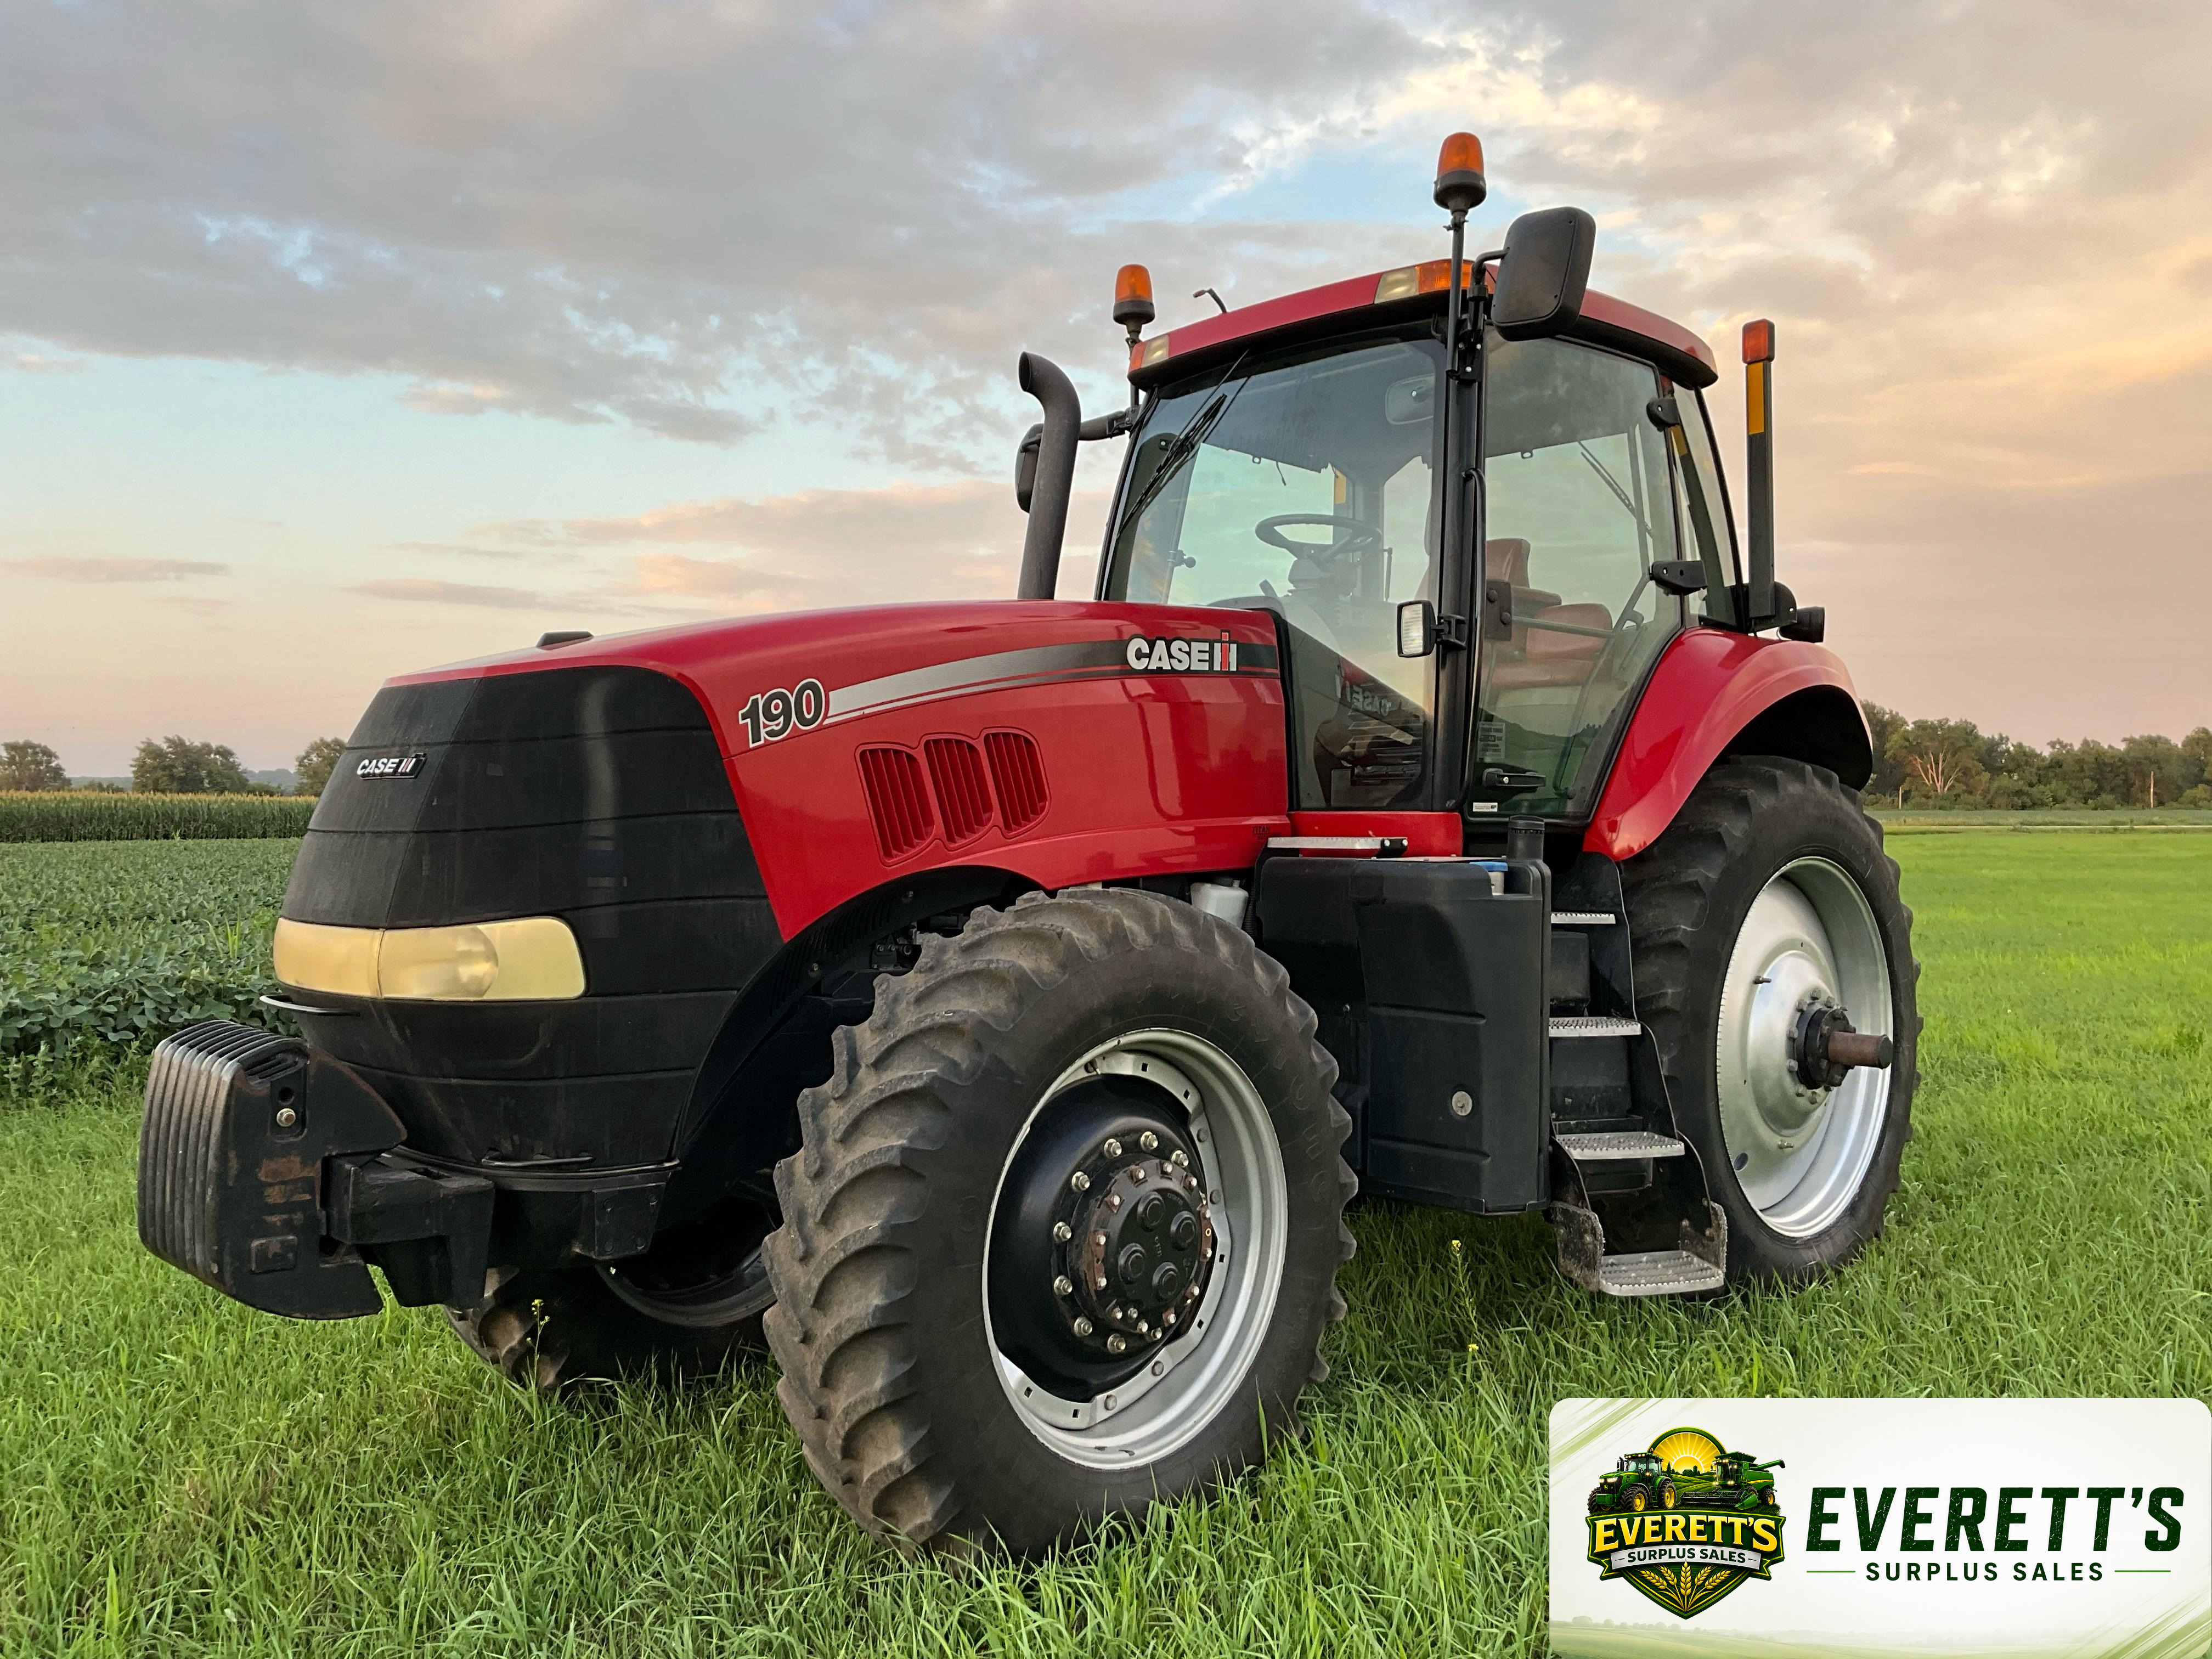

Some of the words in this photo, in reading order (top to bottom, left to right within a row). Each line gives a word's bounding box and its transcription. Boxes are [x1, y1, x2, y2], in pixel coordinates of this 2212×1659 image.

[1126, 637, 1209, 671] CASE
[738, 678, 826, 748] 190
[357, 758, 399, 775] CASE
